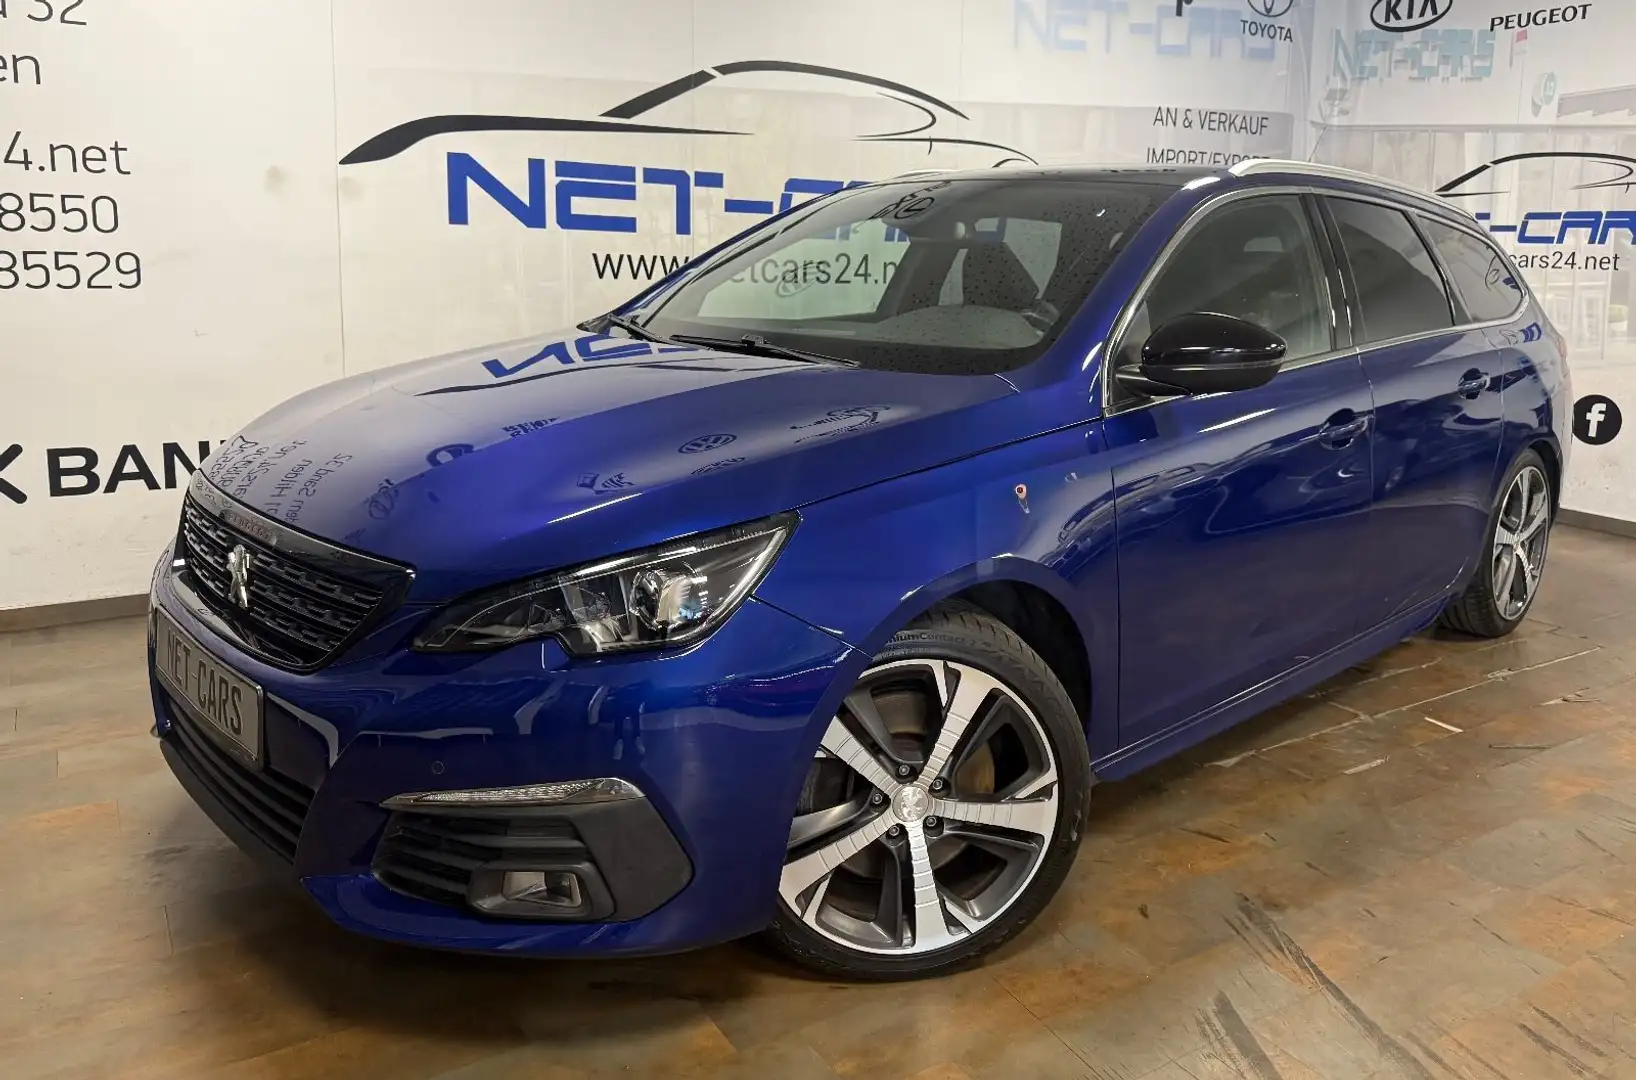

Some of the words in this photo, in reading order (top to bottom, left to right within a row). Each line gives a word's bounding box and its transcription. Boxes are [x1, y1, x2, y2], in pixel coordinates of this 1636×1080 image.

[1384, 0, 1438, 23] KIA
[1489, 4, 1592, 31] PEUGEOT
[1240, 19, 1293, 42] TOYOTA
[1153, 106, 1178, 127] AN
[1182, 108, 1193, 129] &
[1199, 110, 1269, 136] VERKAUF
[0, 192, 119, 234] 8550
[1475, 211, 1636, 246] -CAR
[47, 440, 226, 497] BAN
[167, 628, 243, 736] NET-CARS
